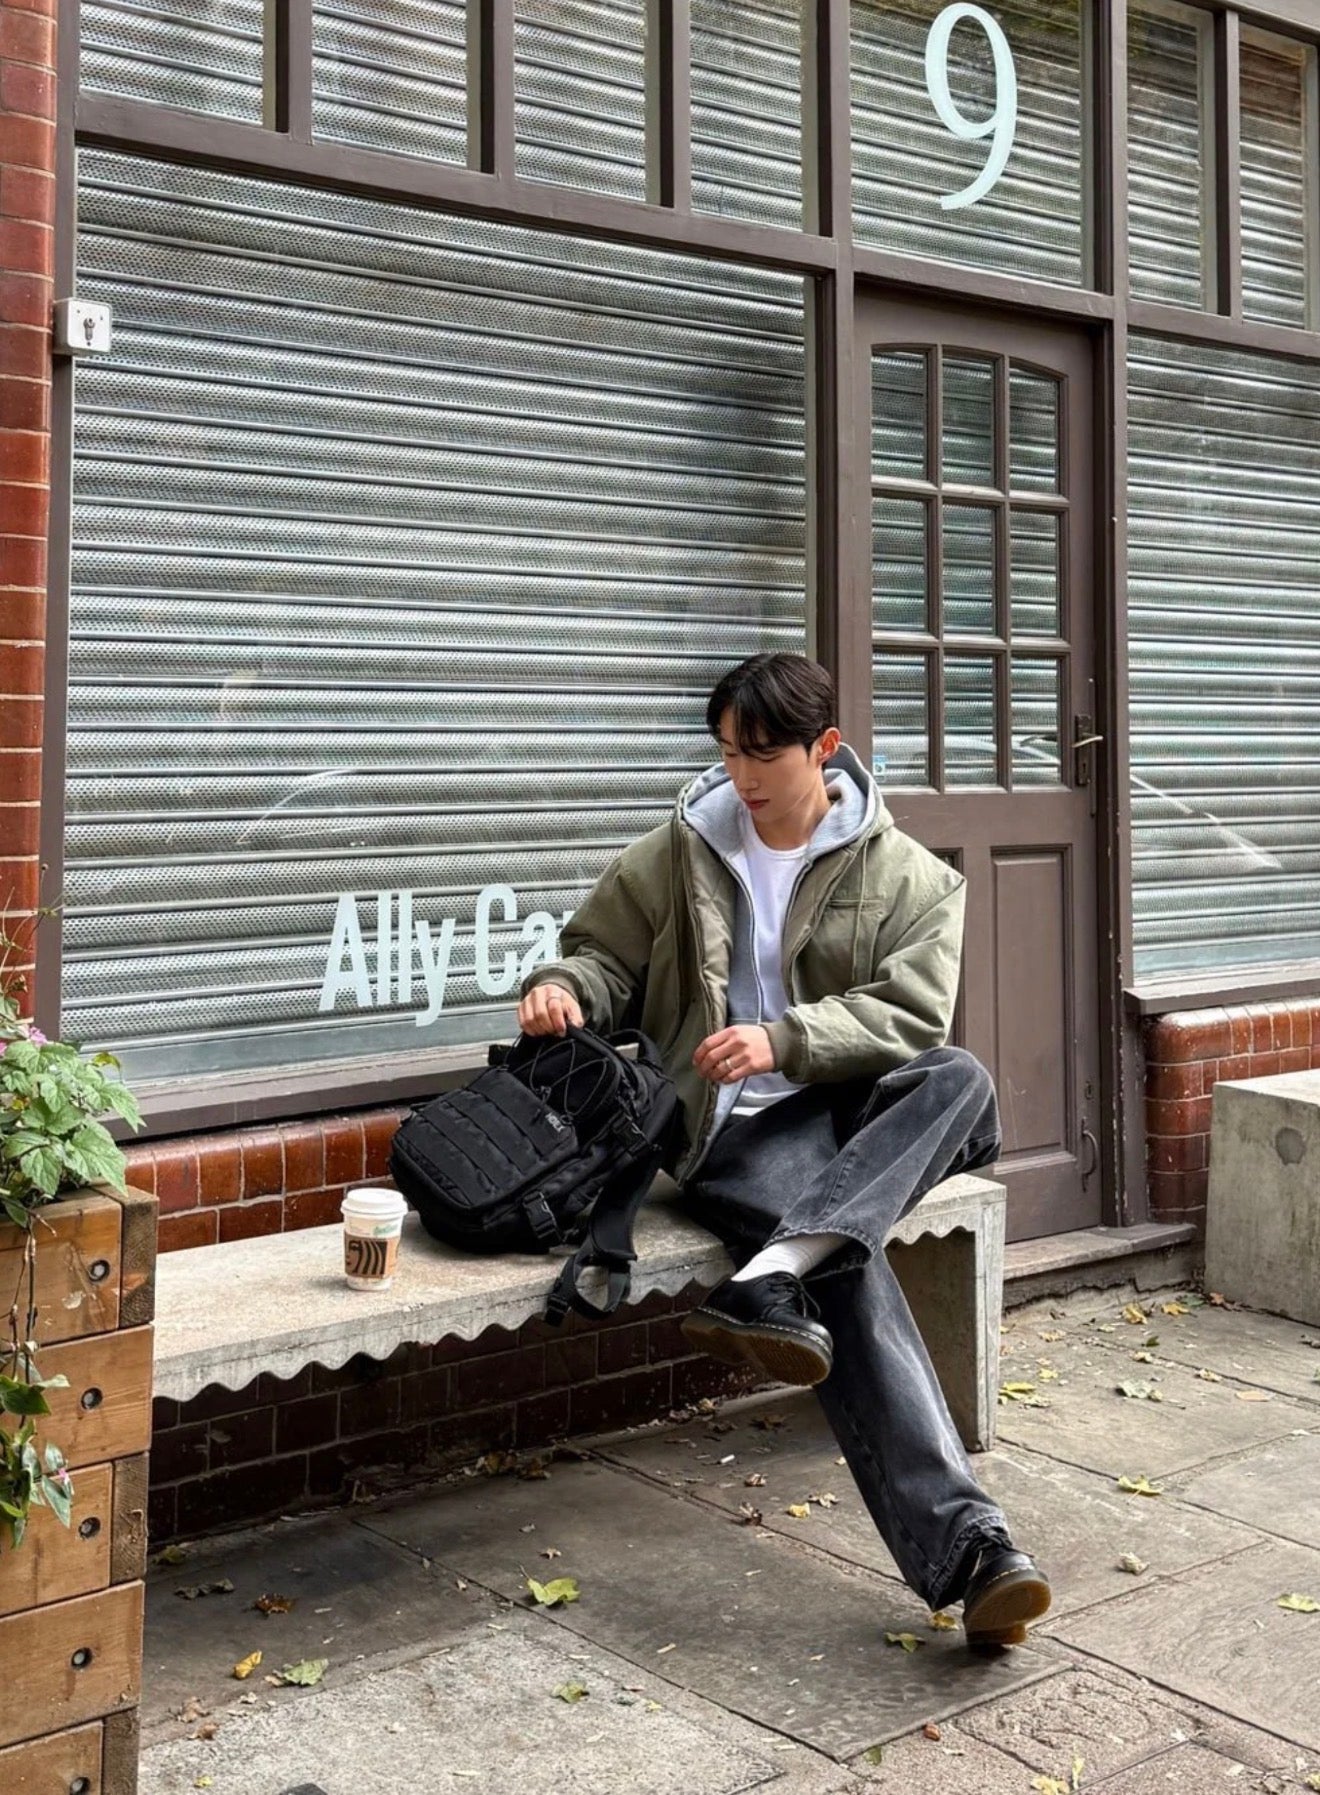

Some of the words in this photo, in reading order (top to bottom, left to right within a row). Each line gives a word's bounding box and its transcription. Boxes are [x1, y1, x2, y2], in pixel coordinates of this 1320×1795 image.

[925, 2, 1018, 210] 9
[318, 890, 456, 1028] Ally
[475, 883, 575, 996] Ca
